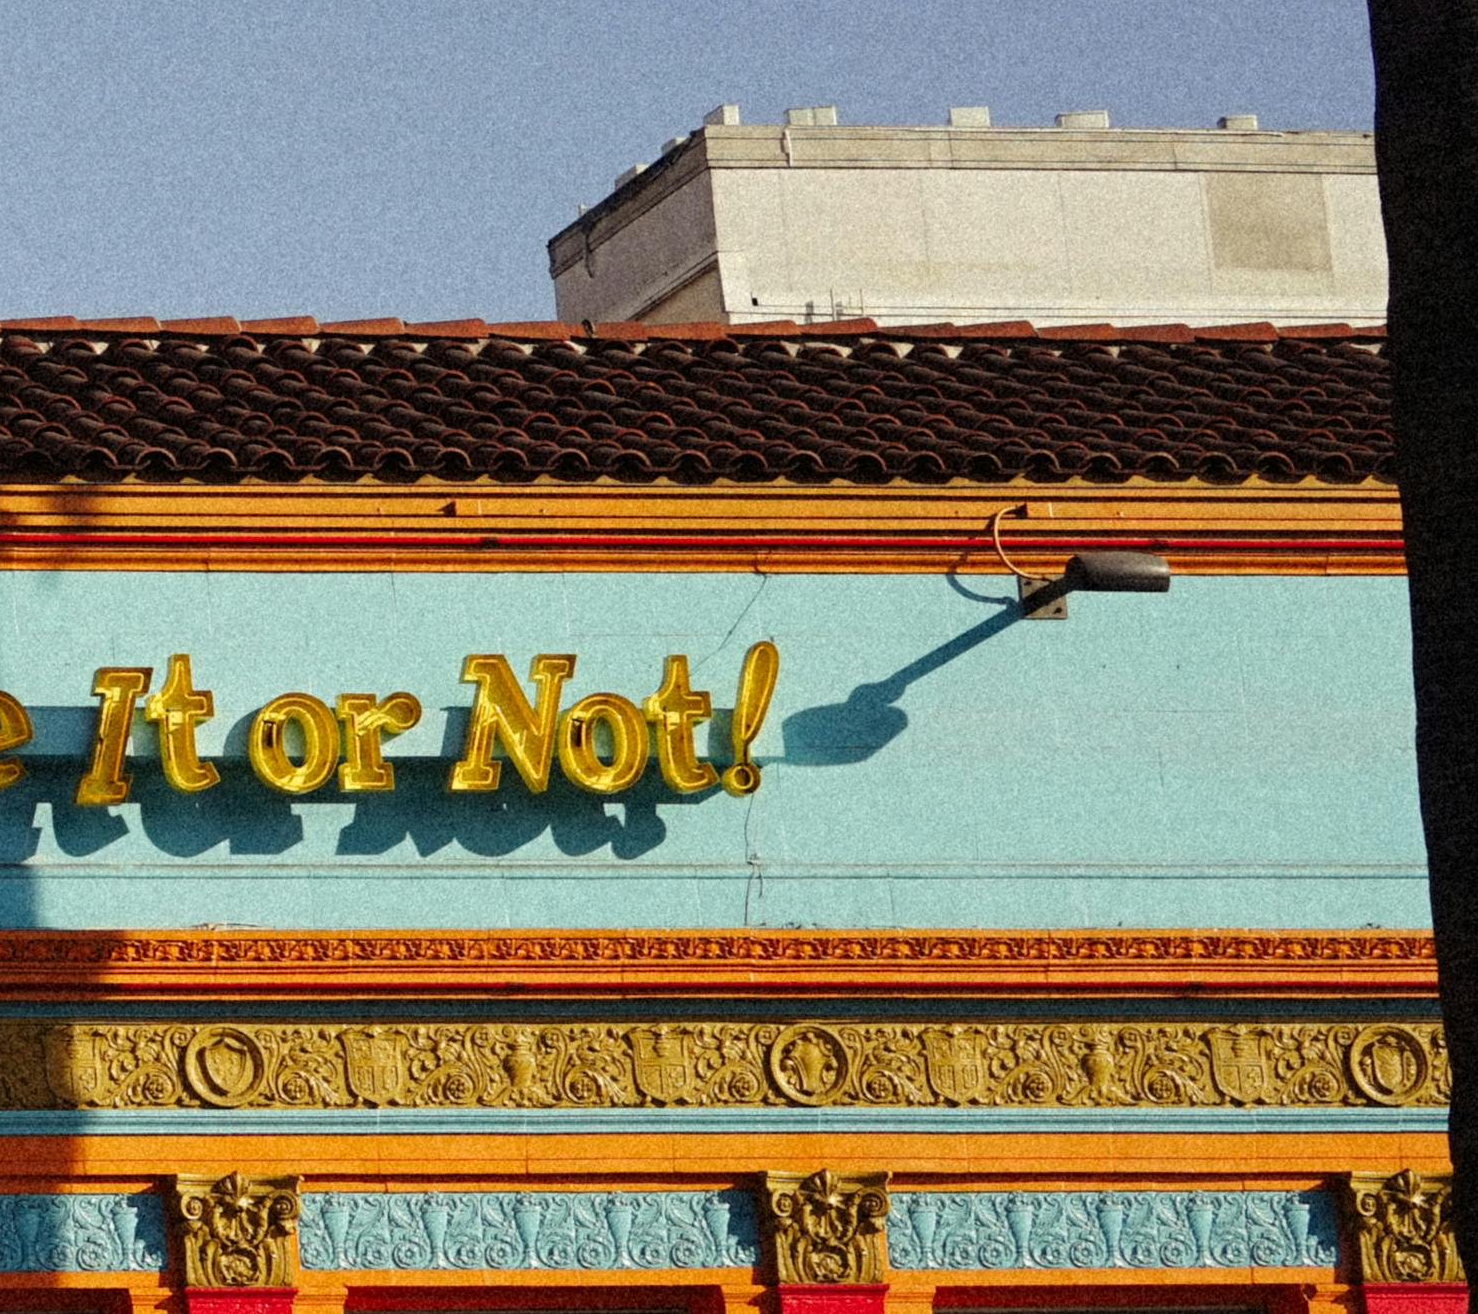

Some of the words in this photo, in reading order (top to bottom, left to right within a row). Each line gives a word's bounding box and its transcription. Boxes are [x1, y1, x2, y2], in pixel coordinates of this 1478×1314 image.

[75, 653, 221, 805] It
[249, 691, 423, 793] or
[448, 640, 779, 798] Not!
